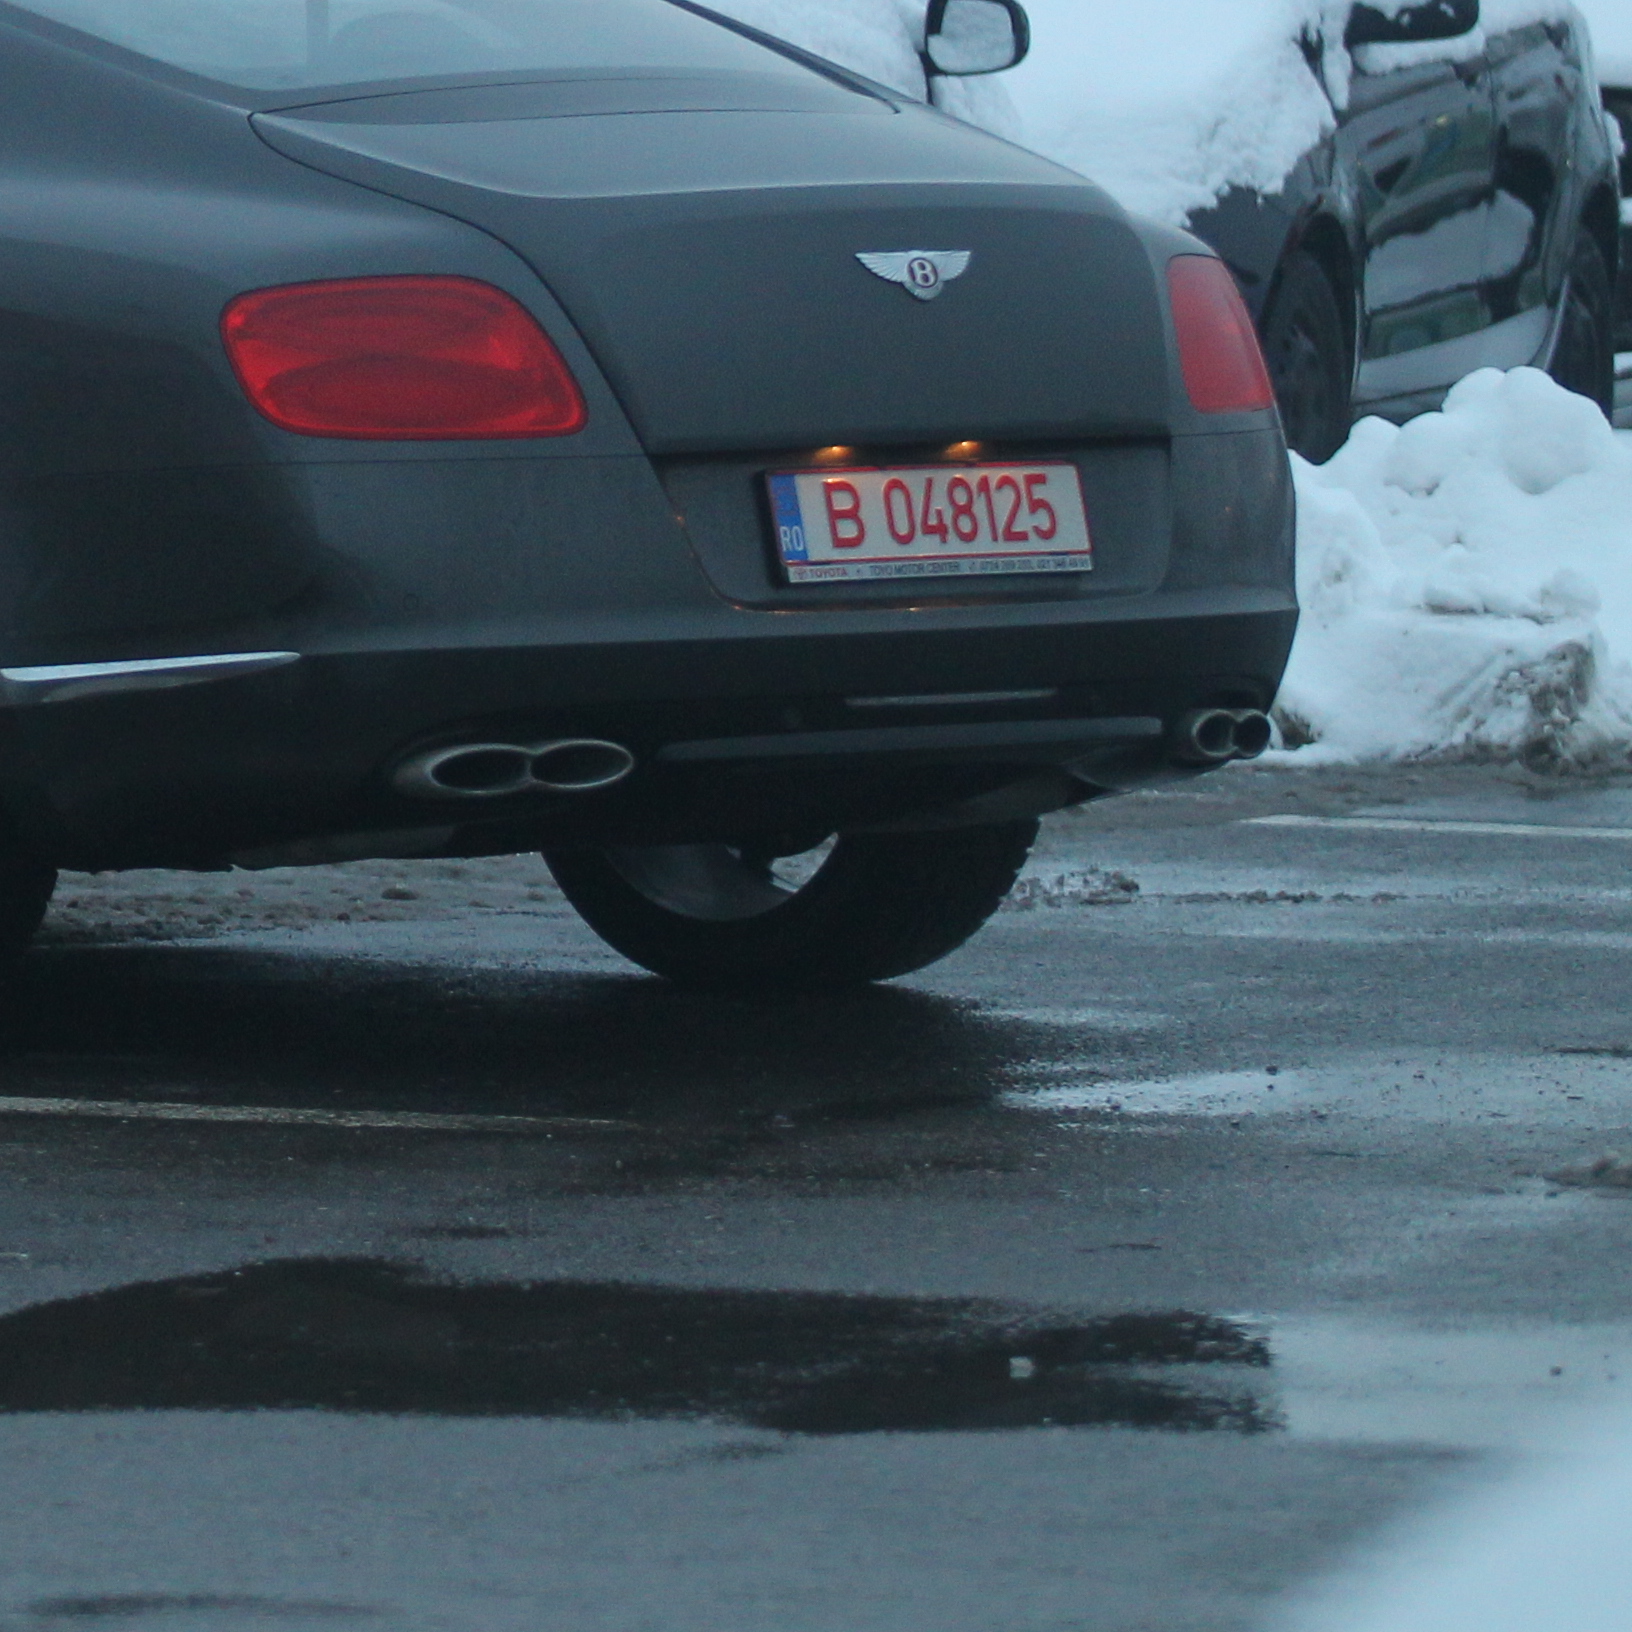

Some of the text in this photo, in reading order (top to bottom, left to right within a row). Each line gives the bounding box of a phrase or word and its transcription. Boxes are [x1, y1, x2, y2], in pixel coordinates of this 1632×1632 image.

[822, 473, 1057, 548] B 048125
[780, 525, 804, 552] RO
[809, 567, 848, 577] TOYOTA
